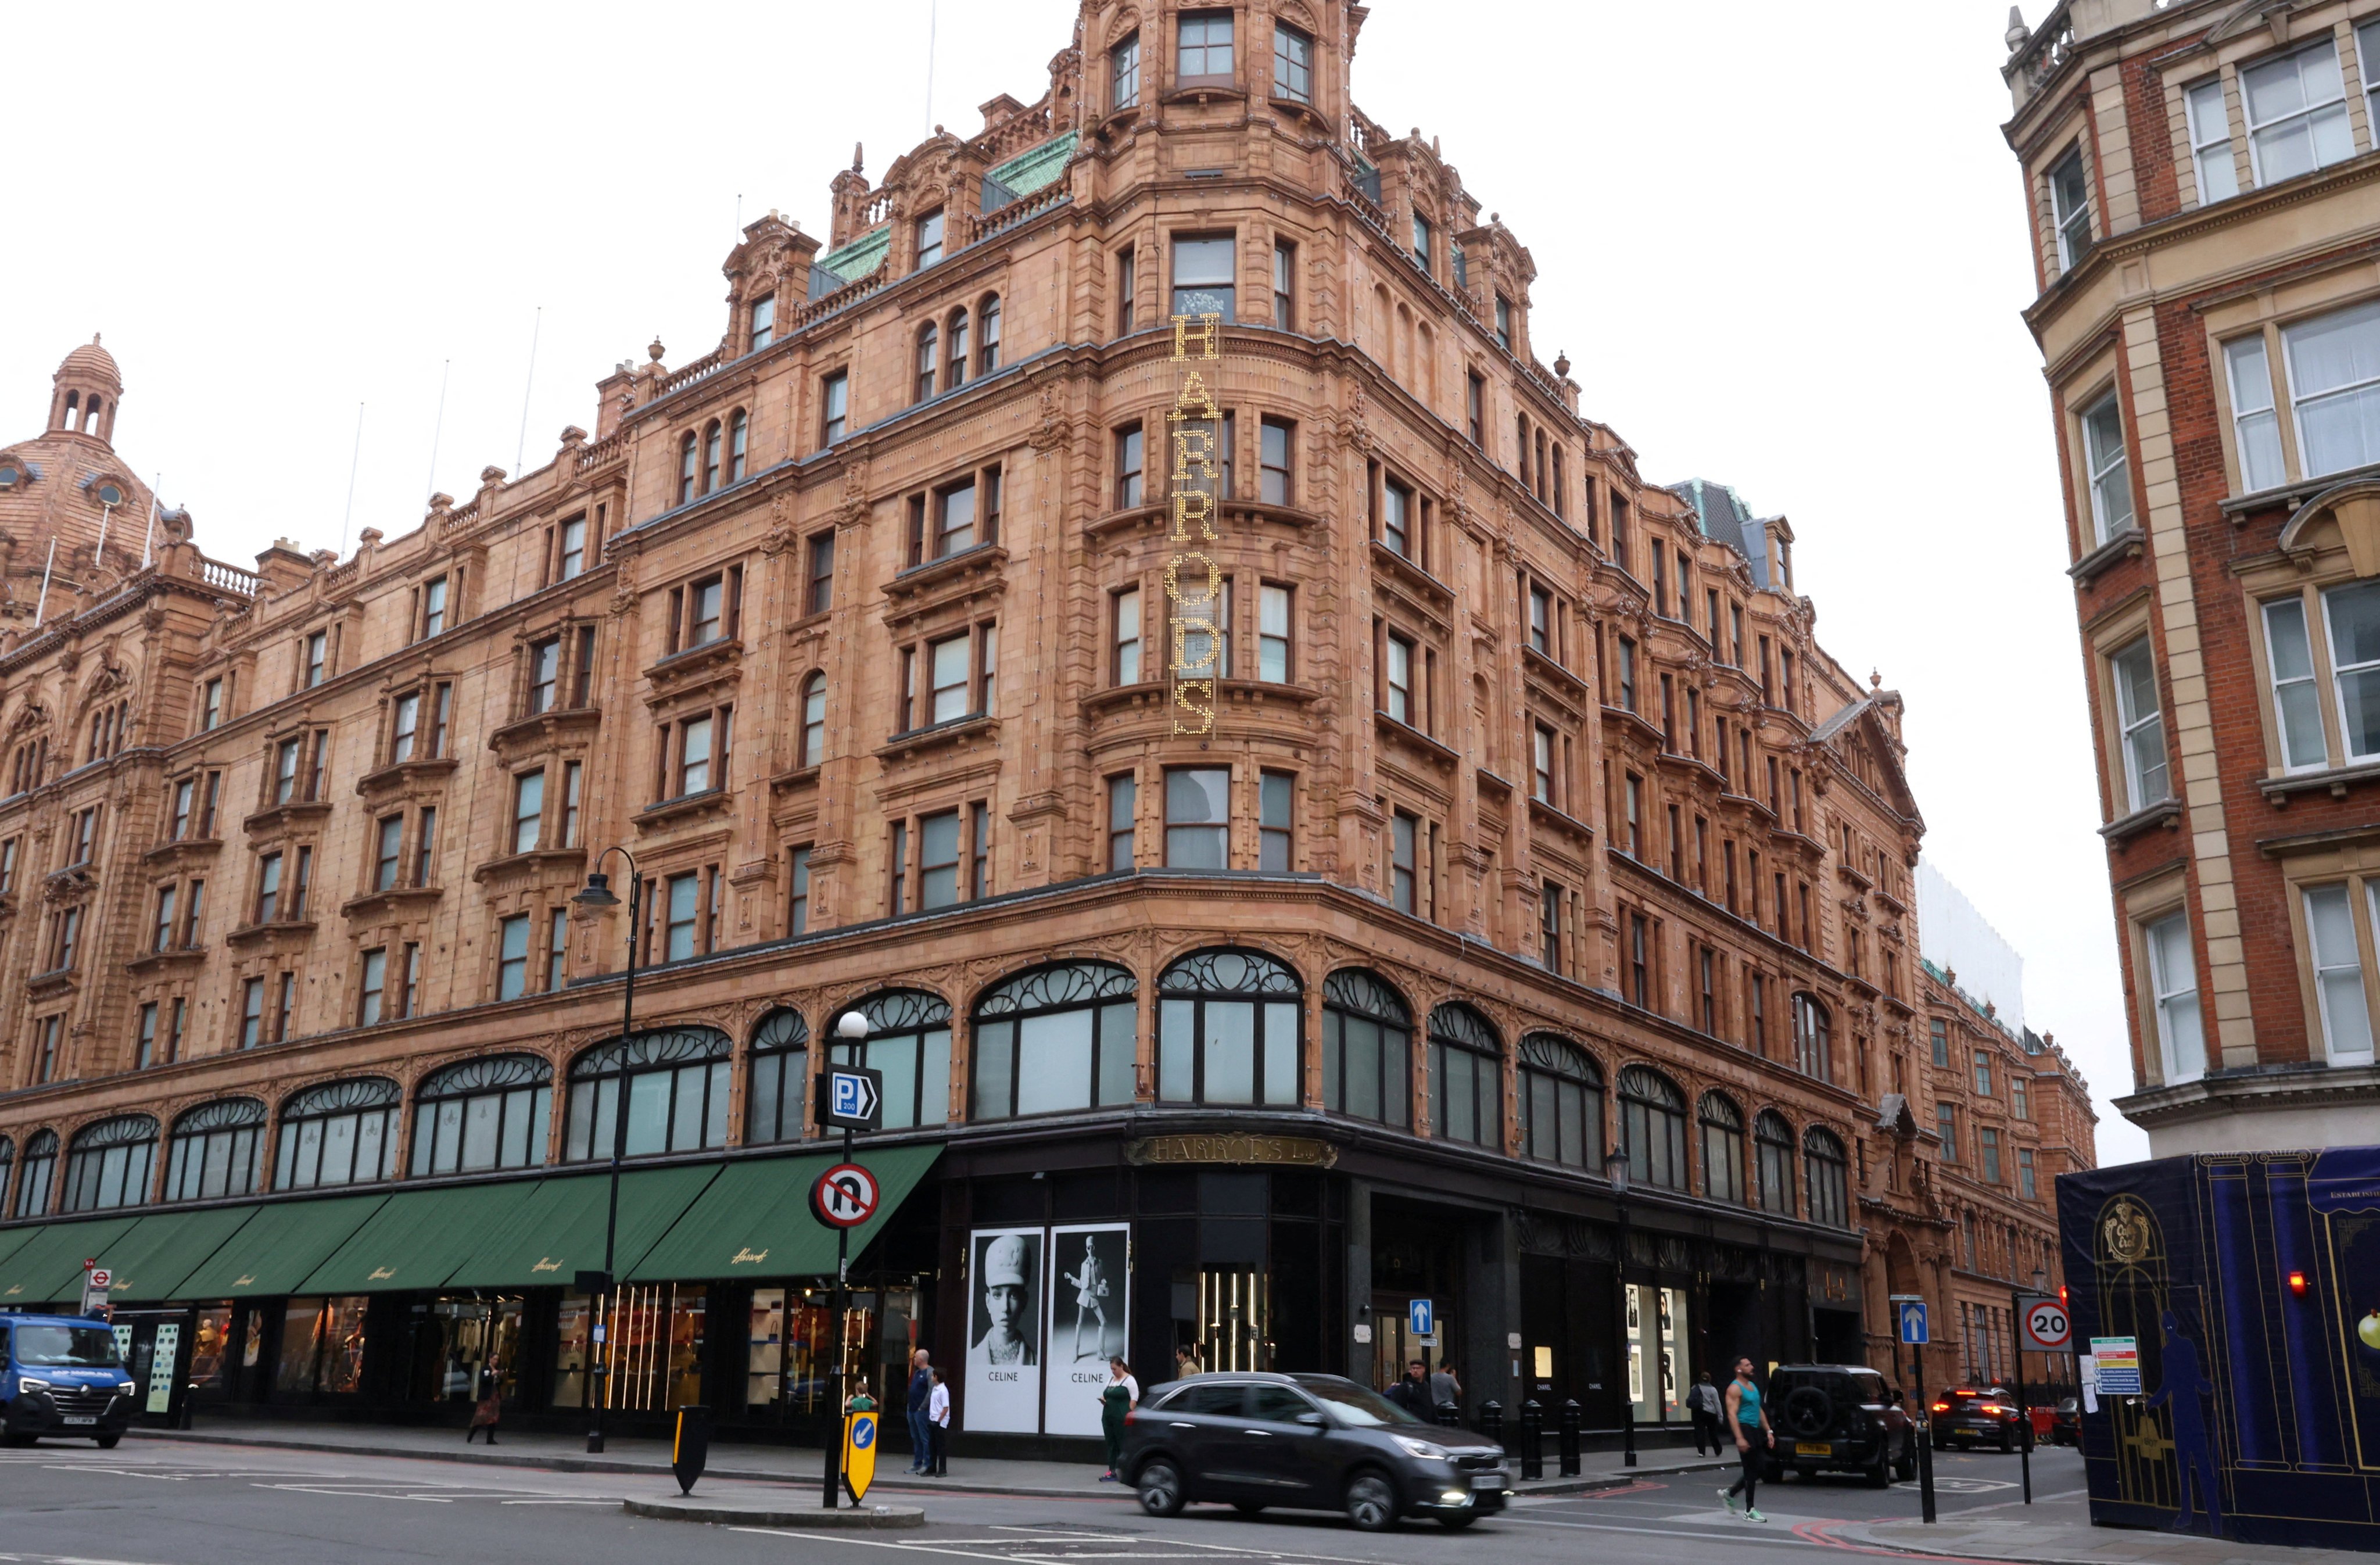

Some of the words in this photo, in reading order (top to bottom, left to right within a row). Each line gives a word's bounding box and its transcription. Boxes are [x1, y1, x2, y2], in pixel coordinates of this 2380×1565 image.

[1163, 312, 1223, 736] HARRODS
[836, 1079, 854, 1111] P
[843, 1102, 855, 1111] 200
[1153, 1138, 1282, 1161] HARRODS
[731, 1247, 769, 1265] Harrods
[2034, 1315, 2066, 1333] 20
[988, 1371, 1018, 1381] CELINE
[1071, 1373, 1103, 1383] CELINE
